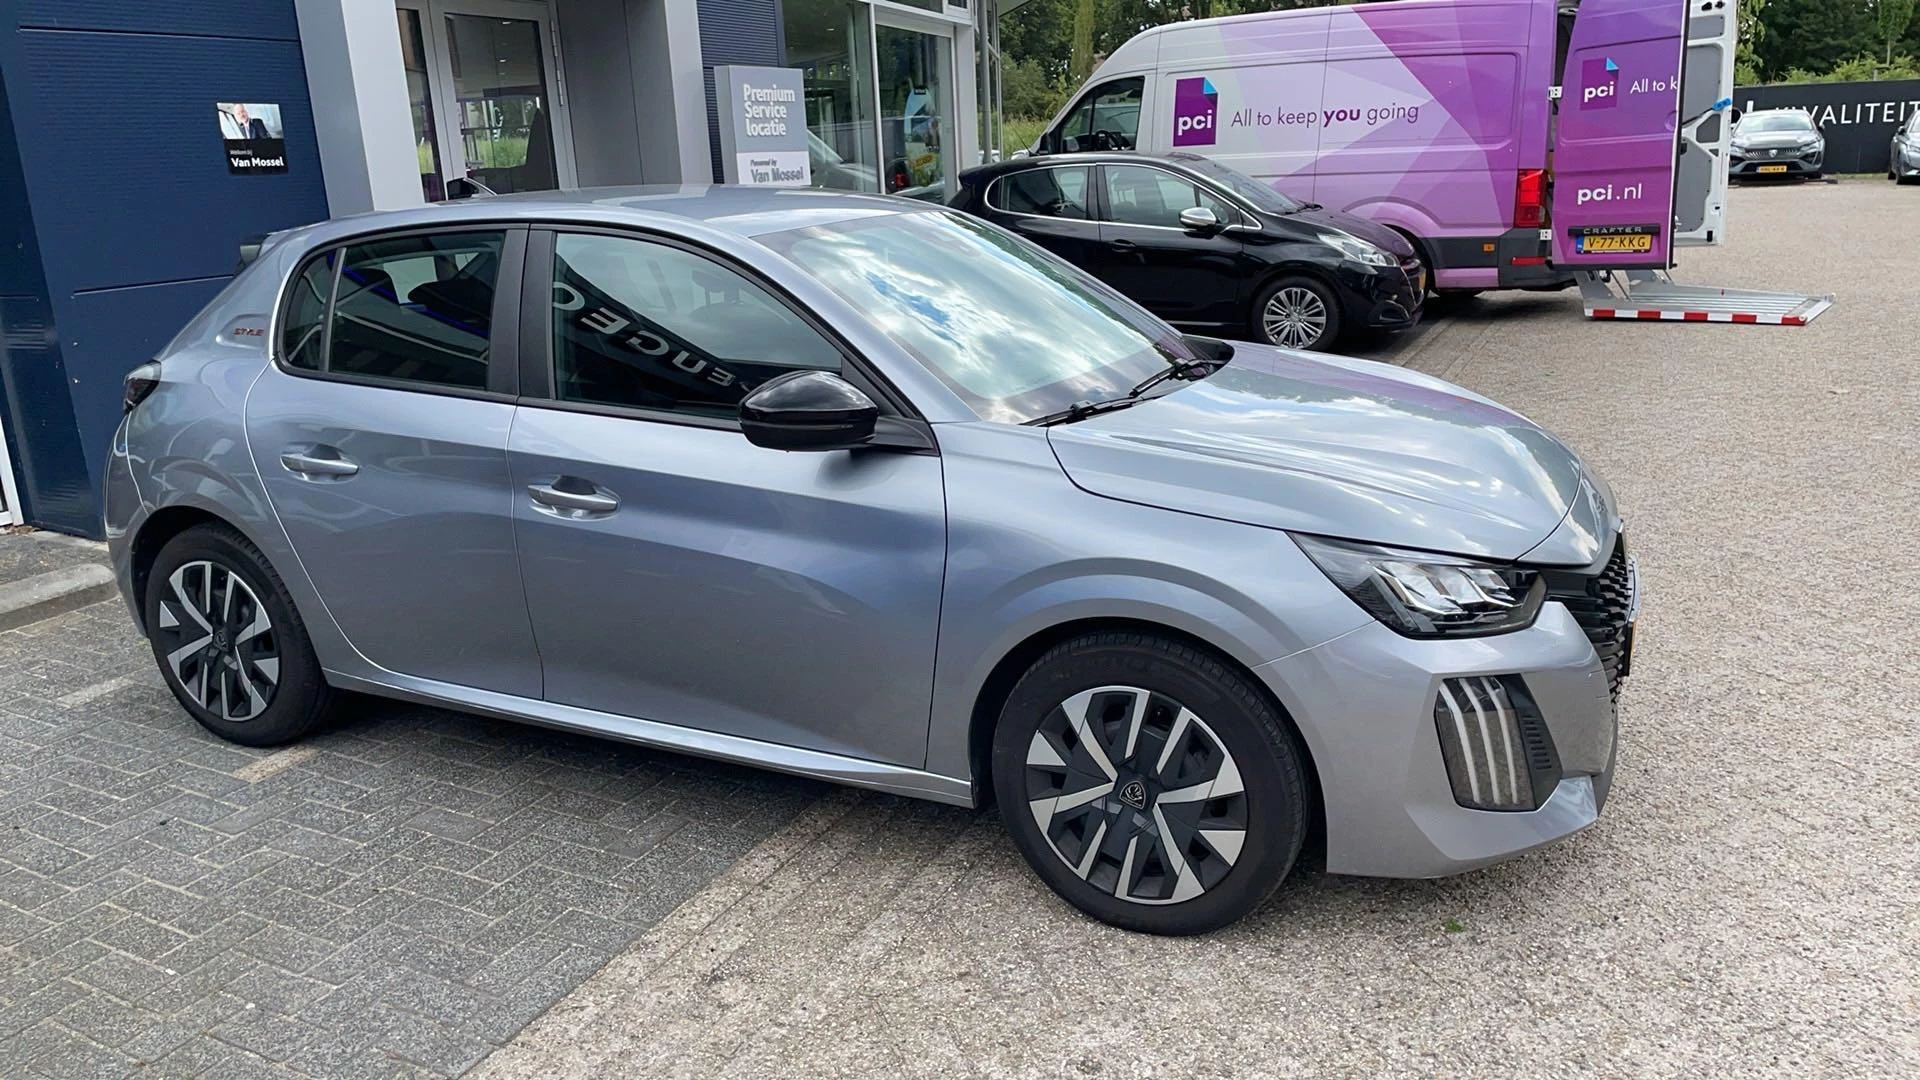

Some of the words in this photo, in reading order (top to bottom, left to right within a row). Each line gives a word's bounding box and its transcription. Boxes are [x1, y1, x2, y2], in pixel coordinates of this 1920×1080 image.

[743, 83, 796, 102] Premium
[1584, 81, 1615, 103] pci
[1630, 78, 1649, 94] All
[1653, 80, 1666, 92] to
[744, 101, 787, 118] Service
[1231, 108, 1252, 127] All
[1257, 109, 1272, 126] to
[1277, 106, 1317, 129] keep
[1323, 108, 1361, 128] you
[1367, 102, 1419, 126] going
[745, 118, 787, 137] locatie
[1177, 109, 1213, 137] pci
[231, 157, 251, 168] Van
[251, 155, 285, 167] Mossel
[751, 168, 770, 183] Van
[771, 166, 804, 182] Mossel
[1577, 183, 1642, 205] pci.nl
[1583, 226, 1642, 235] CRAFTER
[1588, 236, 1646, 249] V-77-KKG
